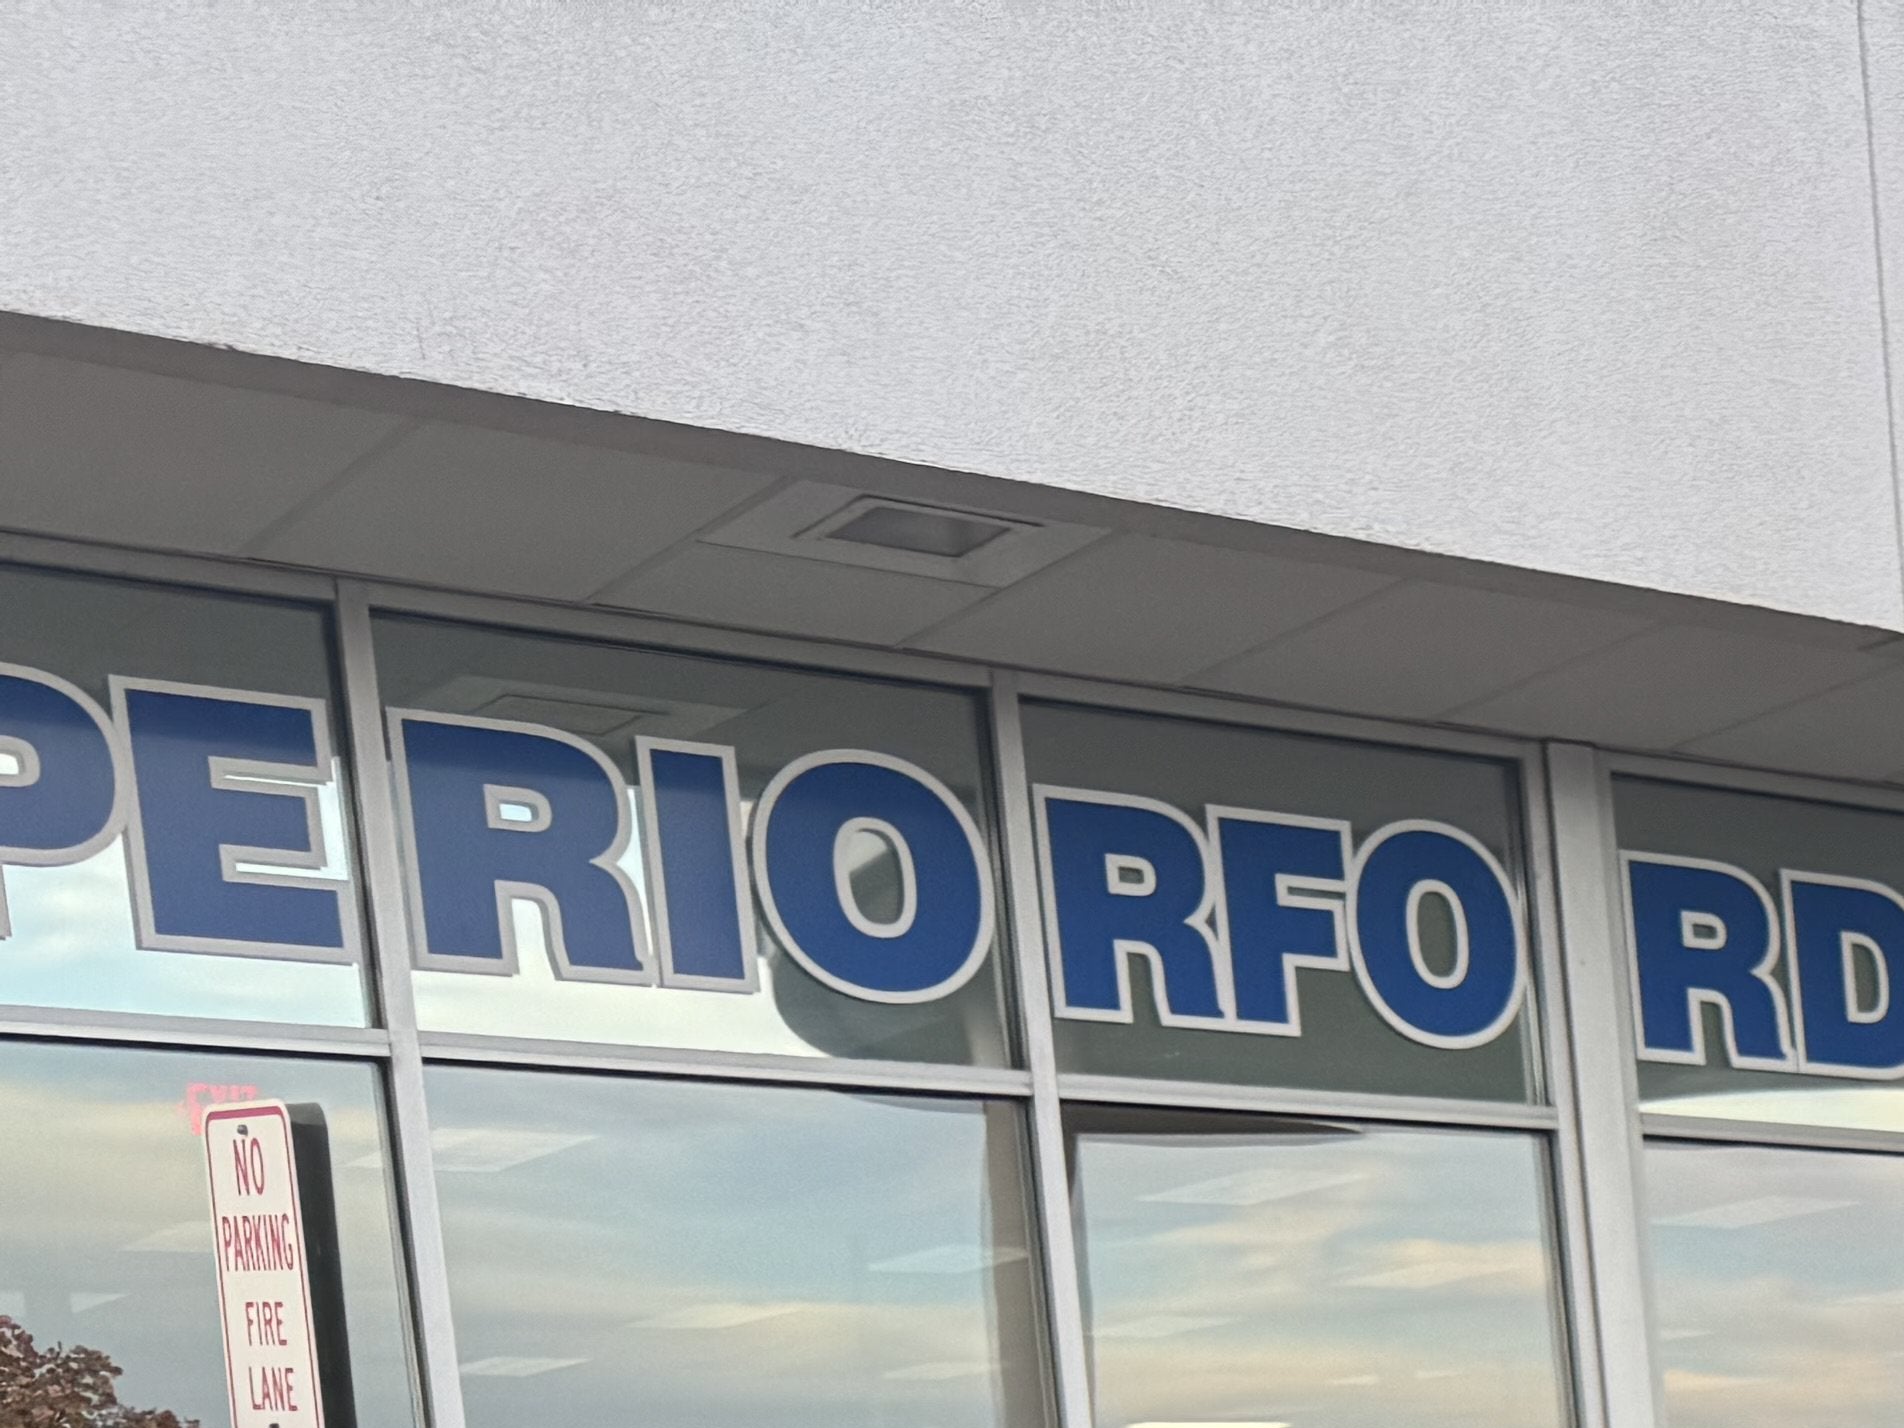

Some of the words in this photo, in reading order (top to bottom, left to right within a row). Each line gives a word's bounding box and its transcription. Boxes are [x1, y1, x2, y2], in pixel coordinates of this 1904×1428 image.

[233, 1137, 265, 1196] NO
[221, 1213, 294, 1272] PARKING
[245, 1301, 288, 1347] FIRE
[249, 1366, 298, 1412] LANE
